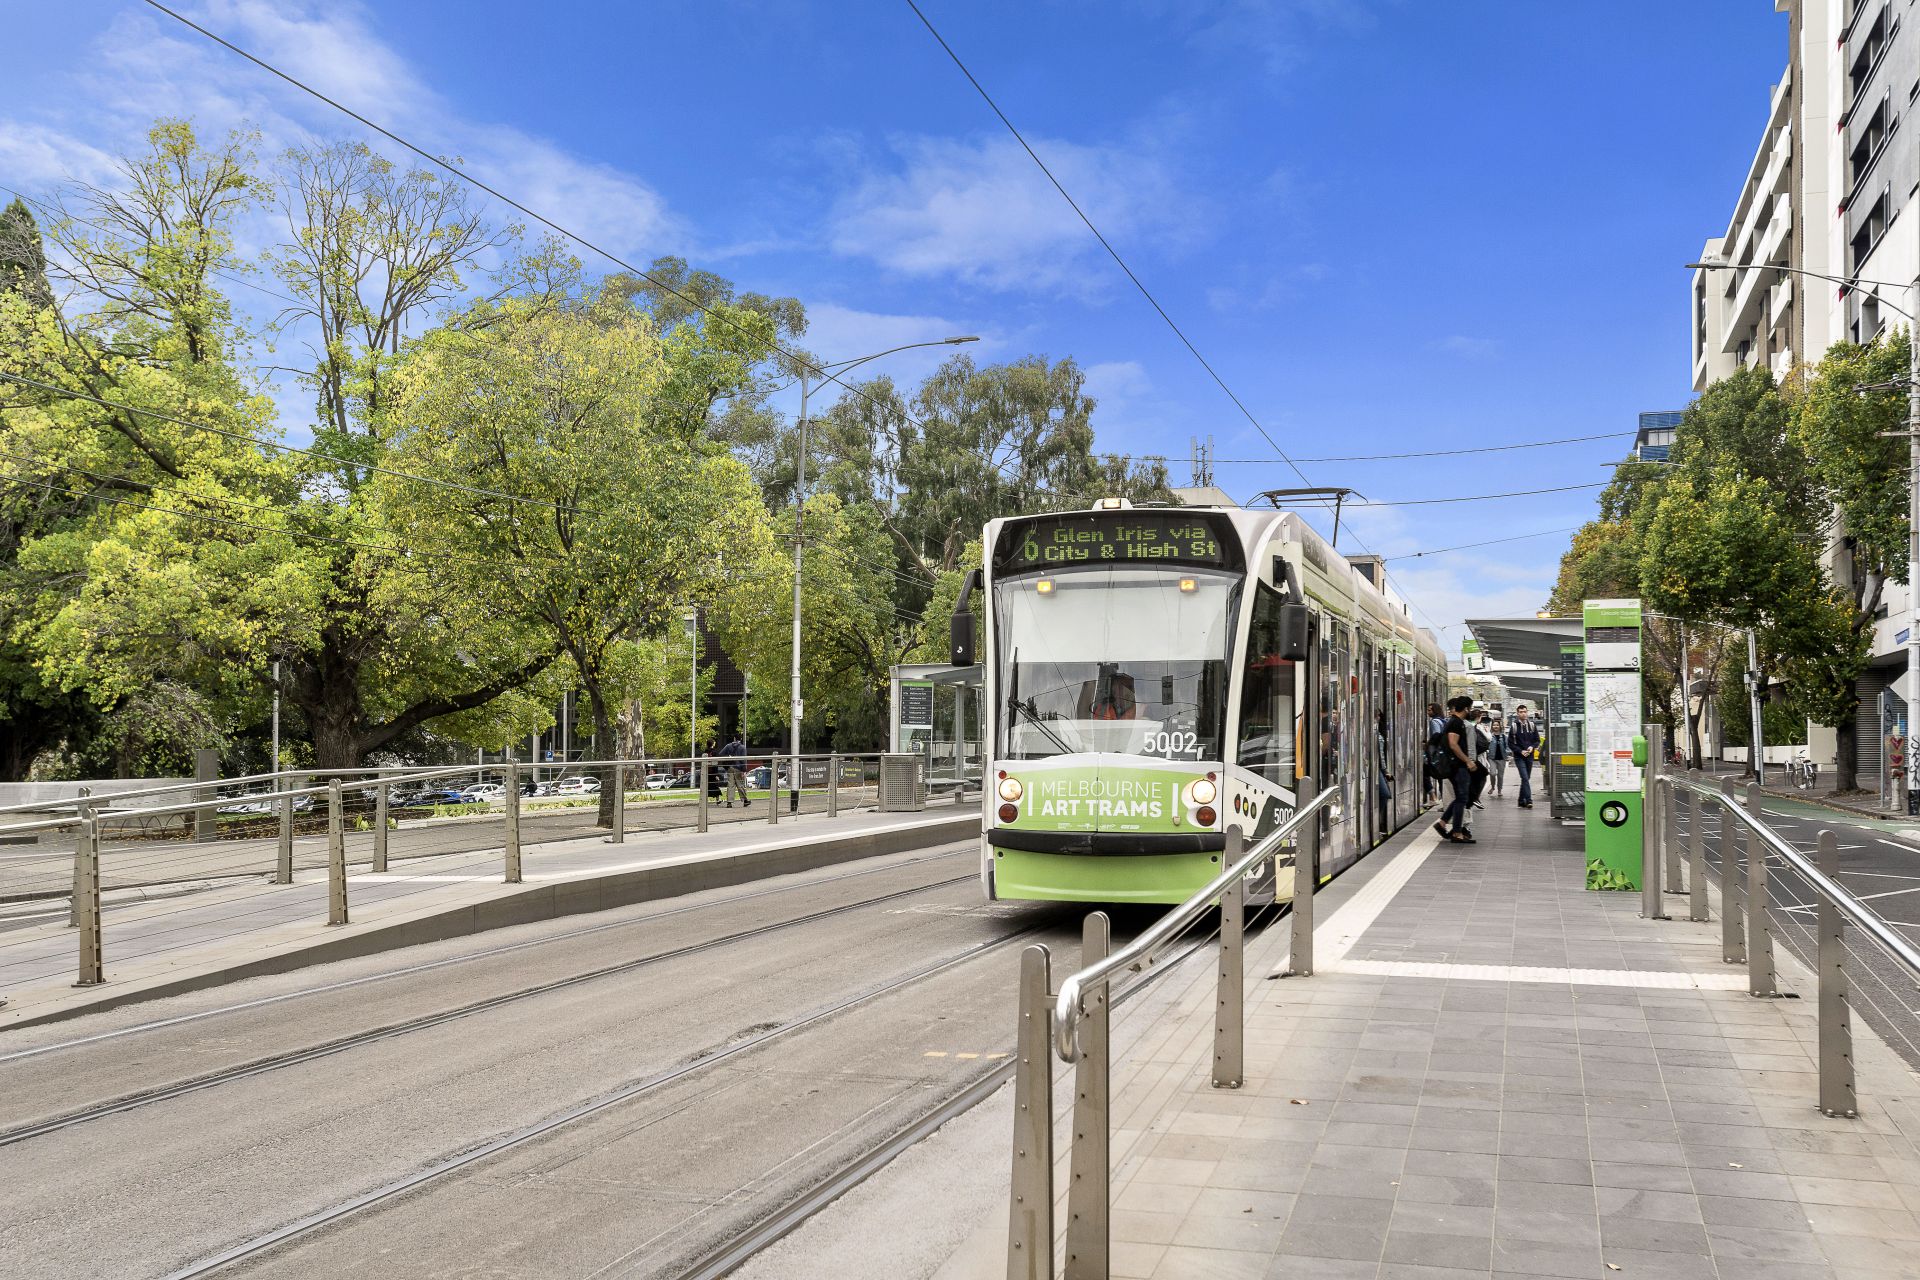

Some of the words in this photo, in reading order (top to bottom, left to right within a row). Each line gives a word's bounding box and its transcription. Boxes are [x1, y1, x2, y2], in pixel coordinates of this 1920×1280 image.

[1053, 528, 1104, 543] Glen
[1115, 526, 1157, 541] Iris
[1169, 524, 1206, 539] via
[1044, 545, 1089, 561] City
[1100, 543, 1116, 559] &
[1127, 542, 1179, 558] High
[1190, 541, 1216, 557] St
[1631, 656, 1639, 667] 3
[1143, 731, 1198, 753] 5002
[1041, 780, 1162, 799] MELBOURNE
[1041, 799, 1084, 817] ART
[1085, 800, 1162, 818] TRAMS
